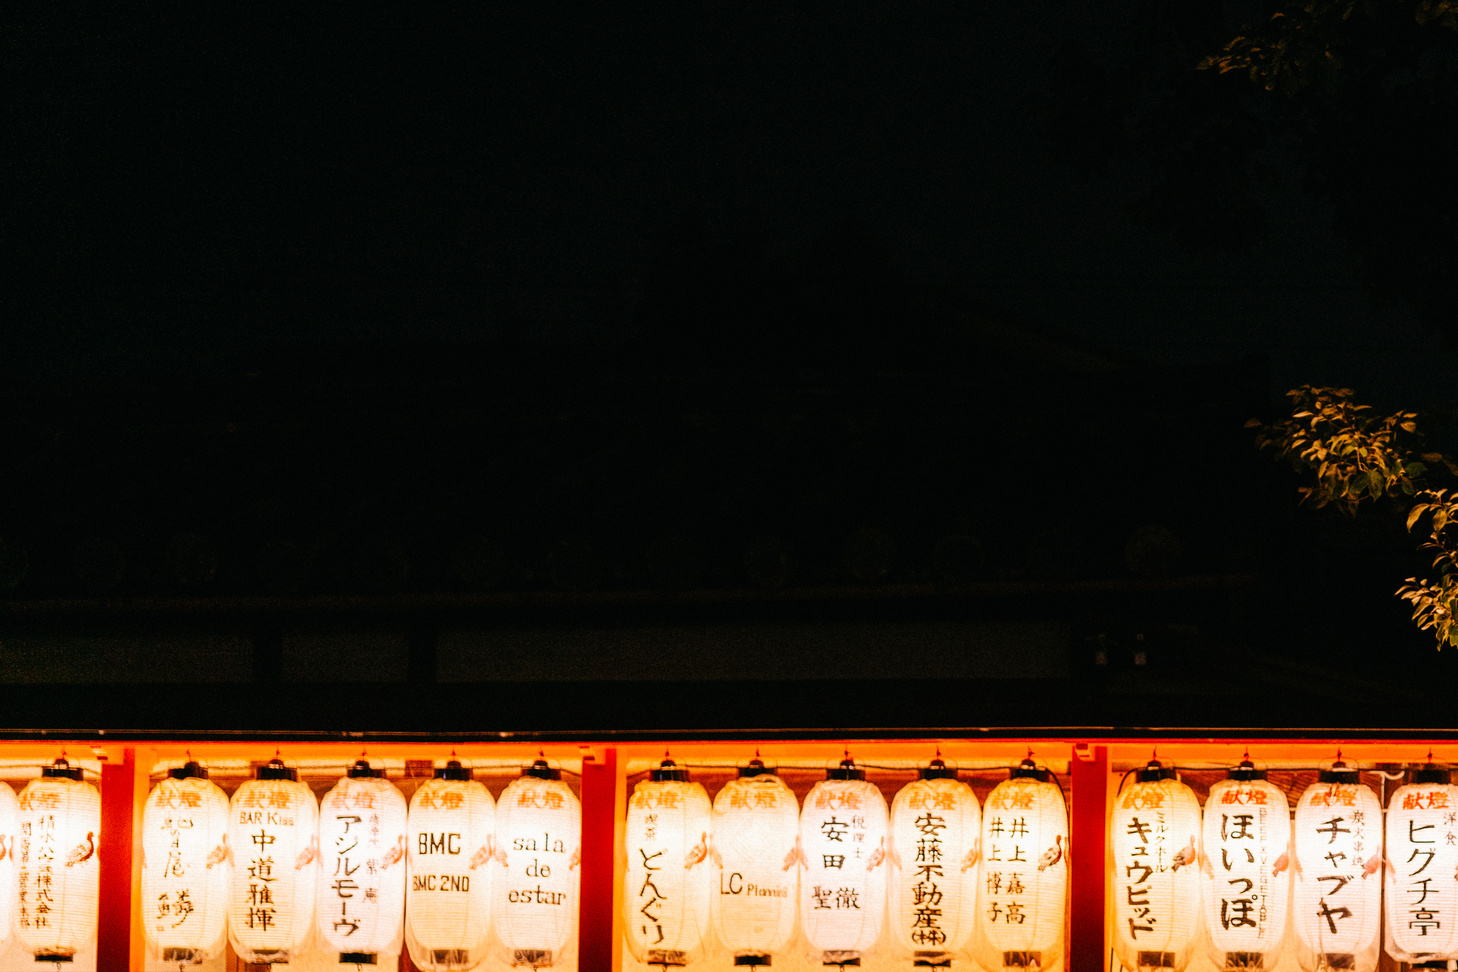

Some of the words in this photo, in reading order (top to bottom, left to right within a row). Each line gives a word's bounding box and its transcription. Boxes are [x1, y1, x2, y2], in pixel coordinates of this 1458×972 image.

[1402, 791, 1451, 810] 献燈
[239, 811, 263, 826] BAR
[1443, 811, 1458, 847] 洋食
[418, 832, 462, 855] BMC
[513, 832, 566, 853] sala
[331, 815, 363, 936] アシルモーヴ
[526, 858, 551, 878] de
[1220, 812, 1259, 931] ほいっぽ
[1316, 816, 1354, 935] チャブヤ
[1406, 819, 1441, 937] ヒグチ亭
[413, 875, 437, 892] BMC
[440, 875, 470, 893] 2ND
[508, 885, 567, 906] estar
[638, 848, 669, 945] どんぐり
